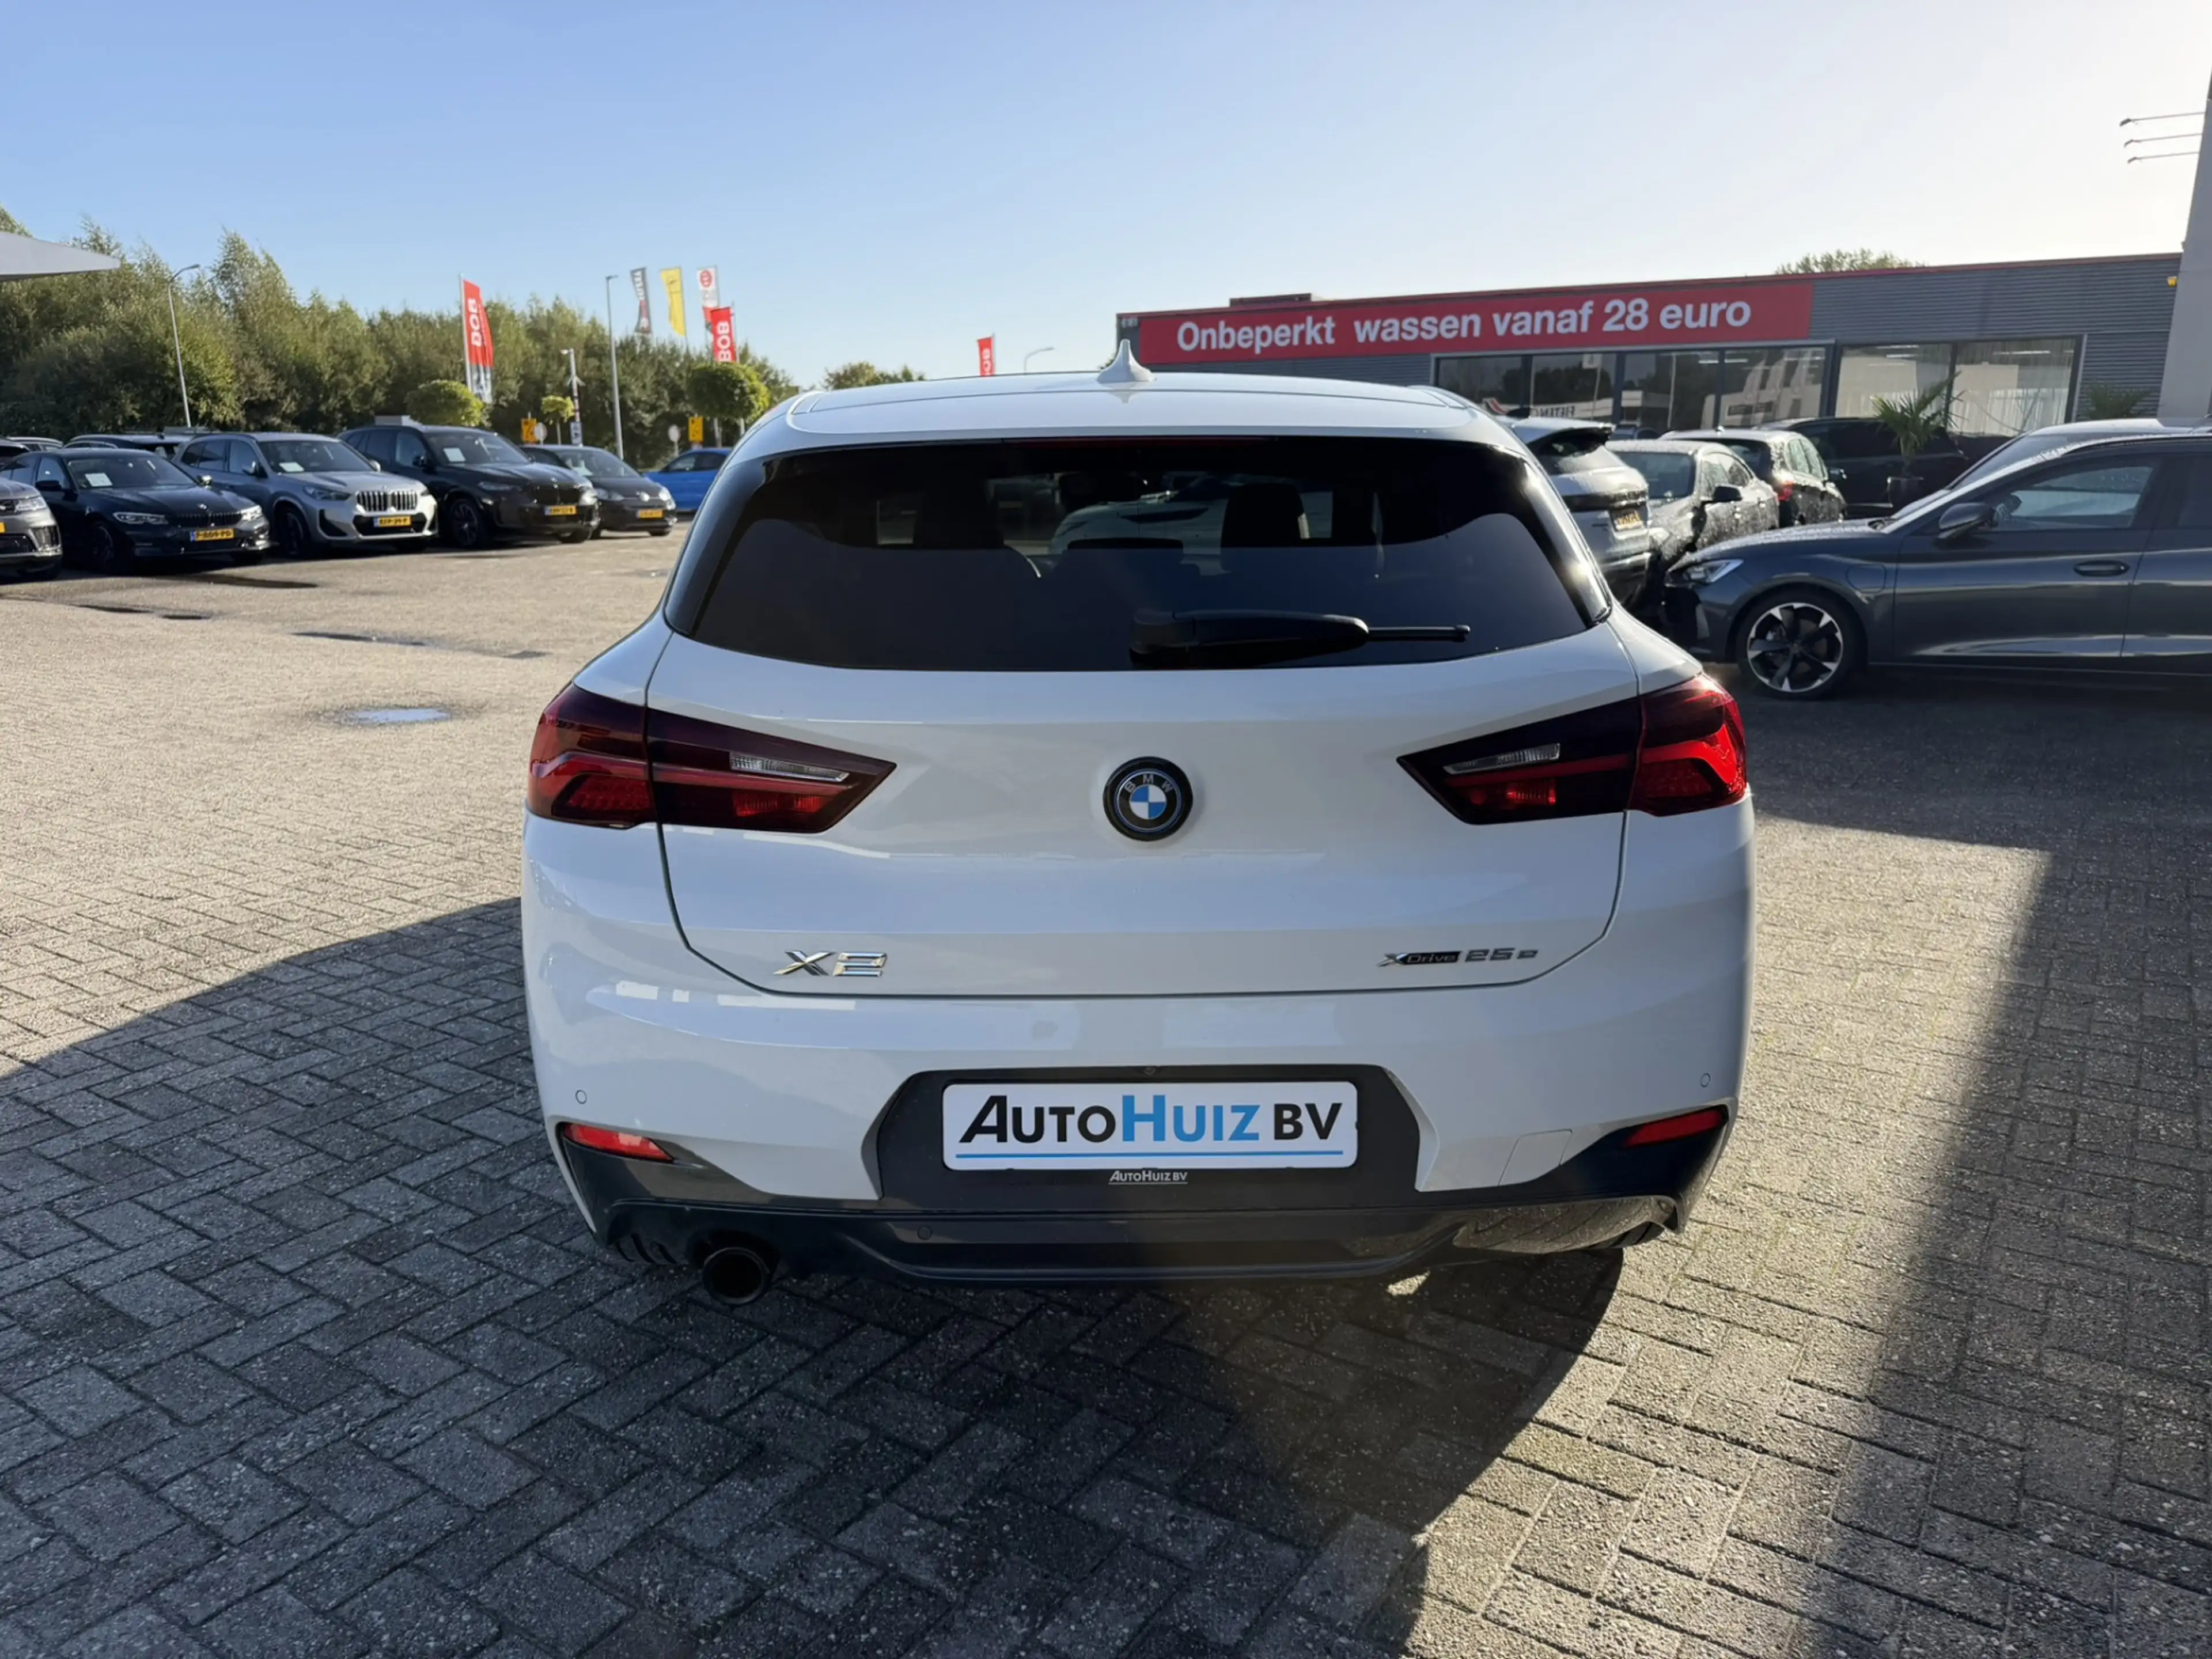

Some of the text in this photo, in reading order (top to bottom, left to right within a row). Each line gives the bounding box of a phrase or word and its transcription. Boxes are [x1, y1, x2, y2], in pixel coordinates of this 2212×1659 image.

[717, 321, 732, 362] BOB
[1177, 298, 1751, 355] Onbeperkt wassen vanaf 28 euro
[1124, 774, 1175, 793] BMW
[772, 950, 887, 977] X2
[1273, 1103, 1343, 1141] BV
[1172, 1172, 1188, 1181] BV
